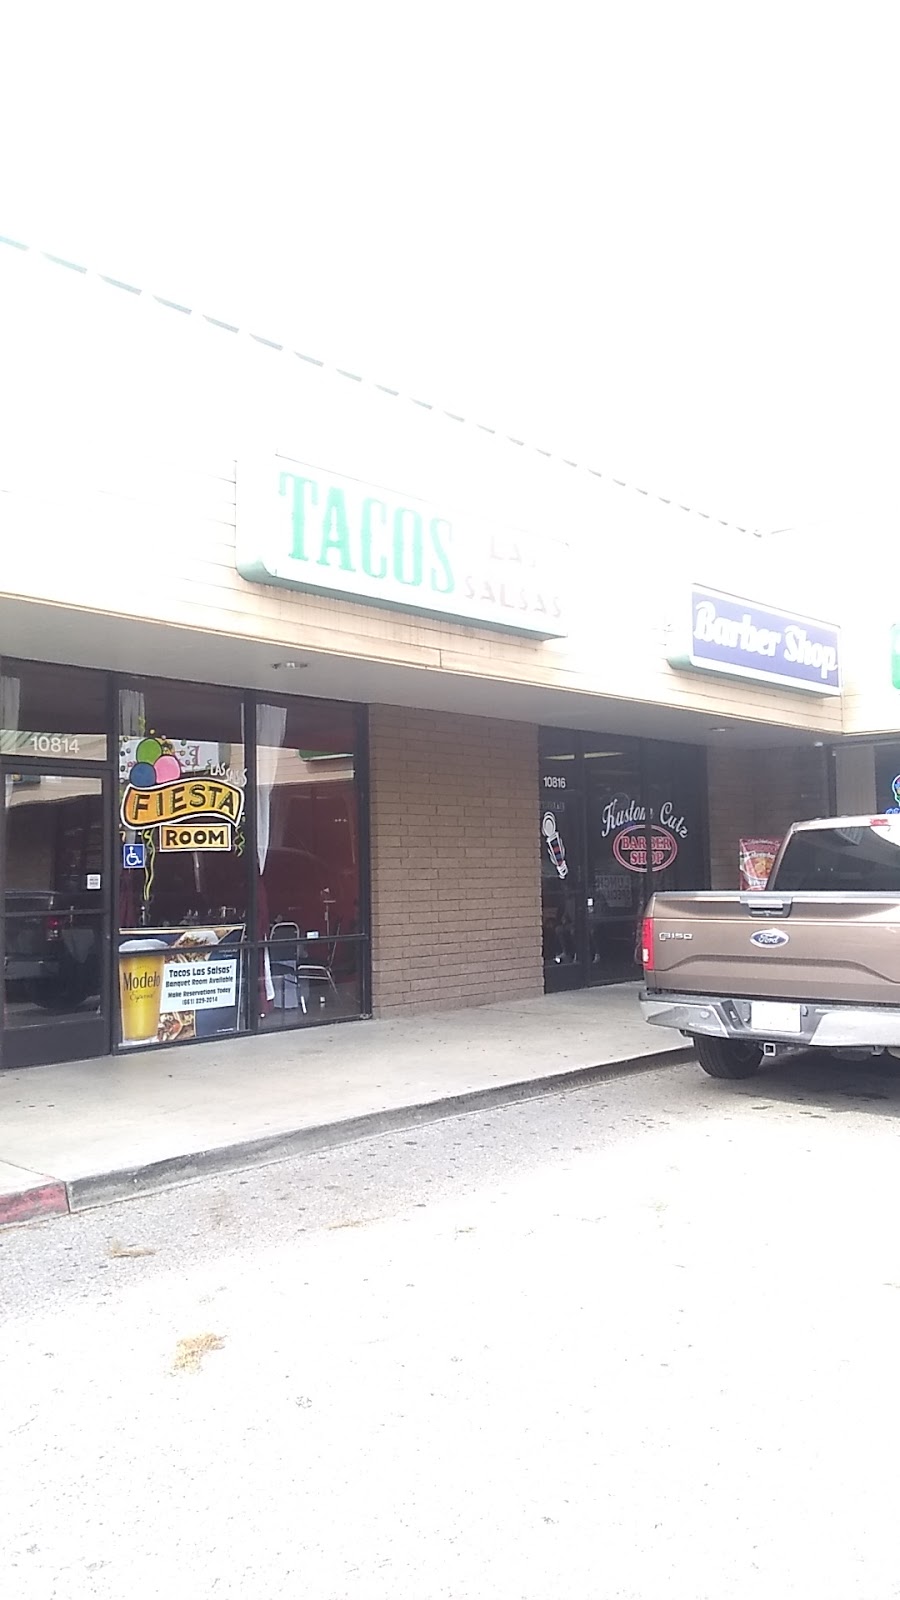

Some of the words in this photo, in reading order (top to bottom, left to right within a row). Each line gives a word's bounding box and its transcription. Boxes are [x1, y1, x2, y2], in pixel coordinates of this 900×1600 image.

[279, 470, 456, 595] TACOS
[464, 575, 563, 618] SALSAS
[693, 600, 781, 657] Barber
[784, 624, 838, 679] Shop
[30, 735, 80, 754] 10814
[210, 762, 226, 777] LAS
[543, 777, 566, 789] 10816
[132, 784, 236, 821] FIESTA
[660, 801, 689, 839] Cutz
[165, 829, 225, 847] ROOM
[620, 836, 672, 850] BARBER
[757, 932, 780, 945] Ford
[123, 971, 161, 991] Modelo
[165, 979, 191, 988] Banquet
[209, 976, 234, 984] Available
[168, 969, 191, 978] Tacos
[192, 968, 206, 976] Las
[183, 988, 216, 997] Reservations
